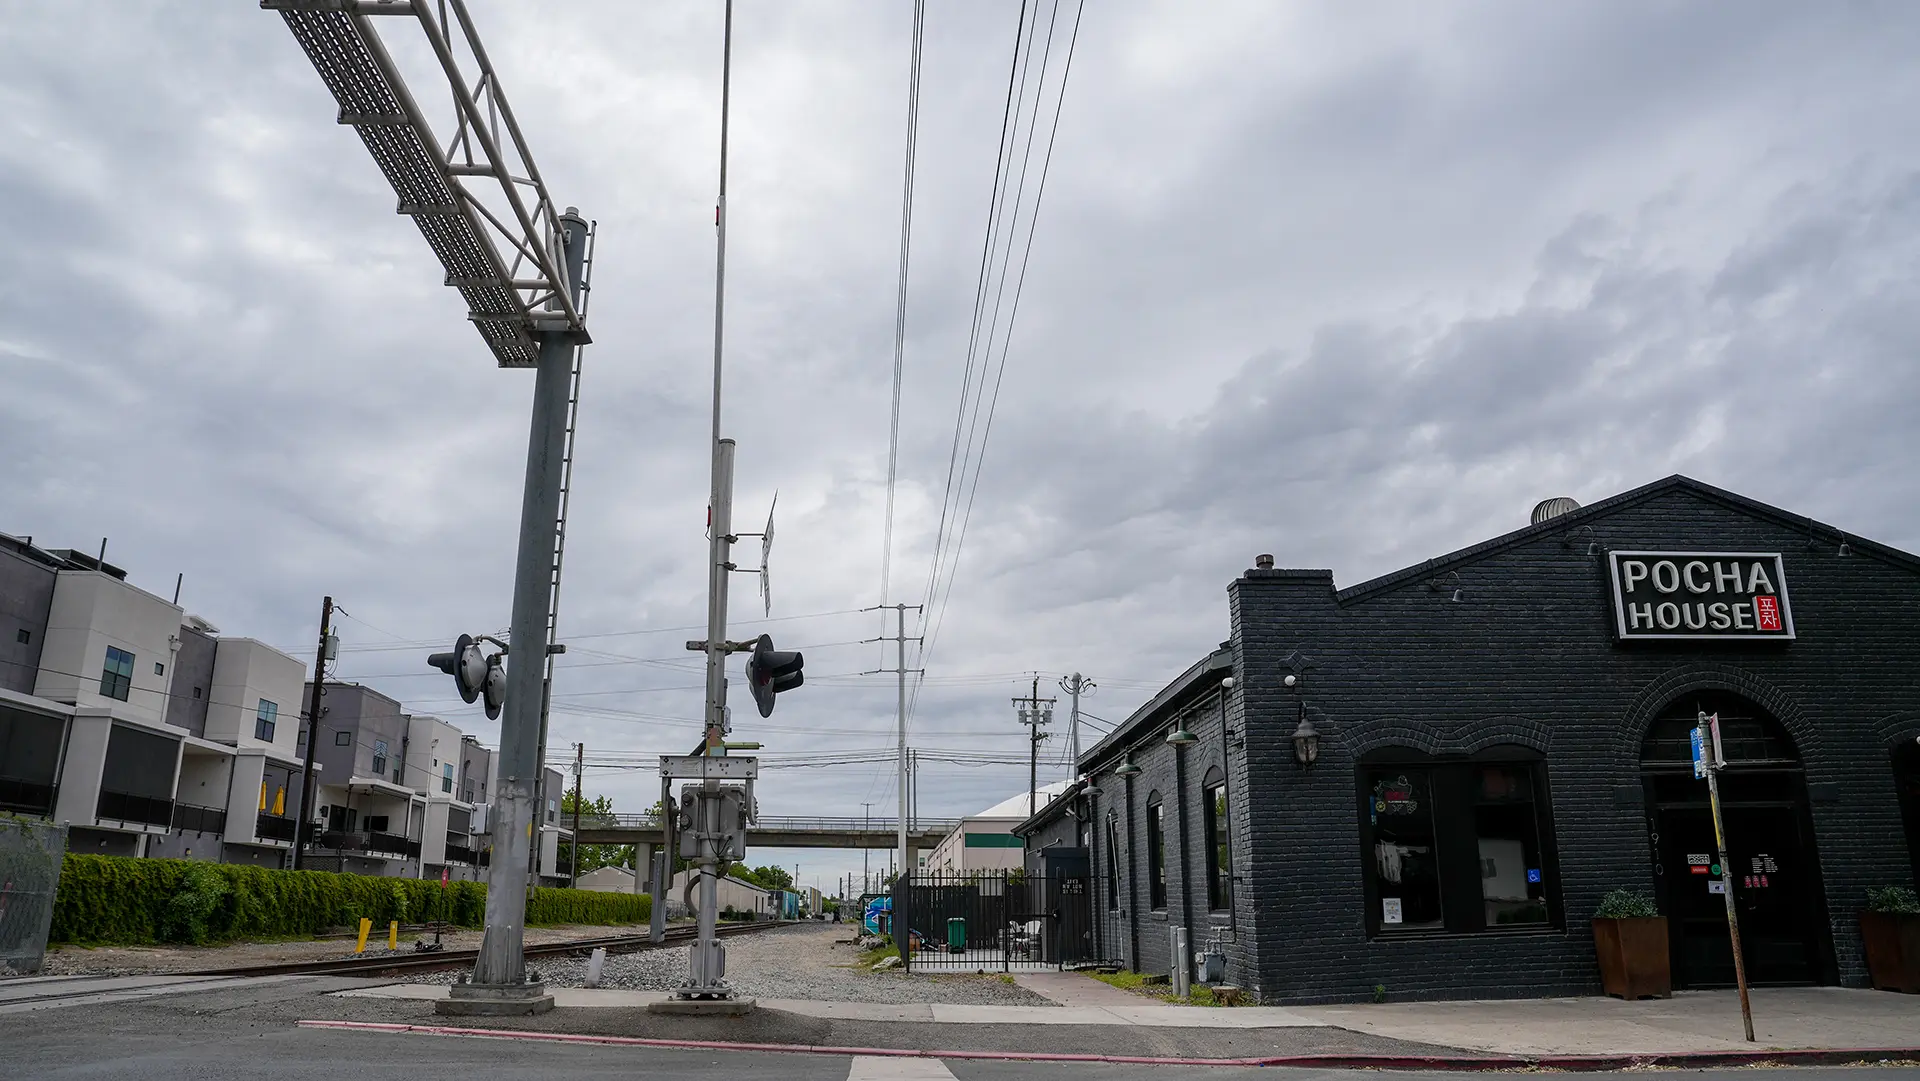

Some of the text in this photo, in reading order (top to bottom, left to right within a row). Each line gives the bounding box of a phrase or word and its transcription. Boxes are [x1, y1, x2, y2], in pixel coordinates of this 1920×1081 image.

[1623, 560, 1775, 594] POCHA
[1628, 602, 1754, 630] HOUSE
[1760, 598, 1778, 628] 포차
[1650, 817, 1664, 876] 1910
